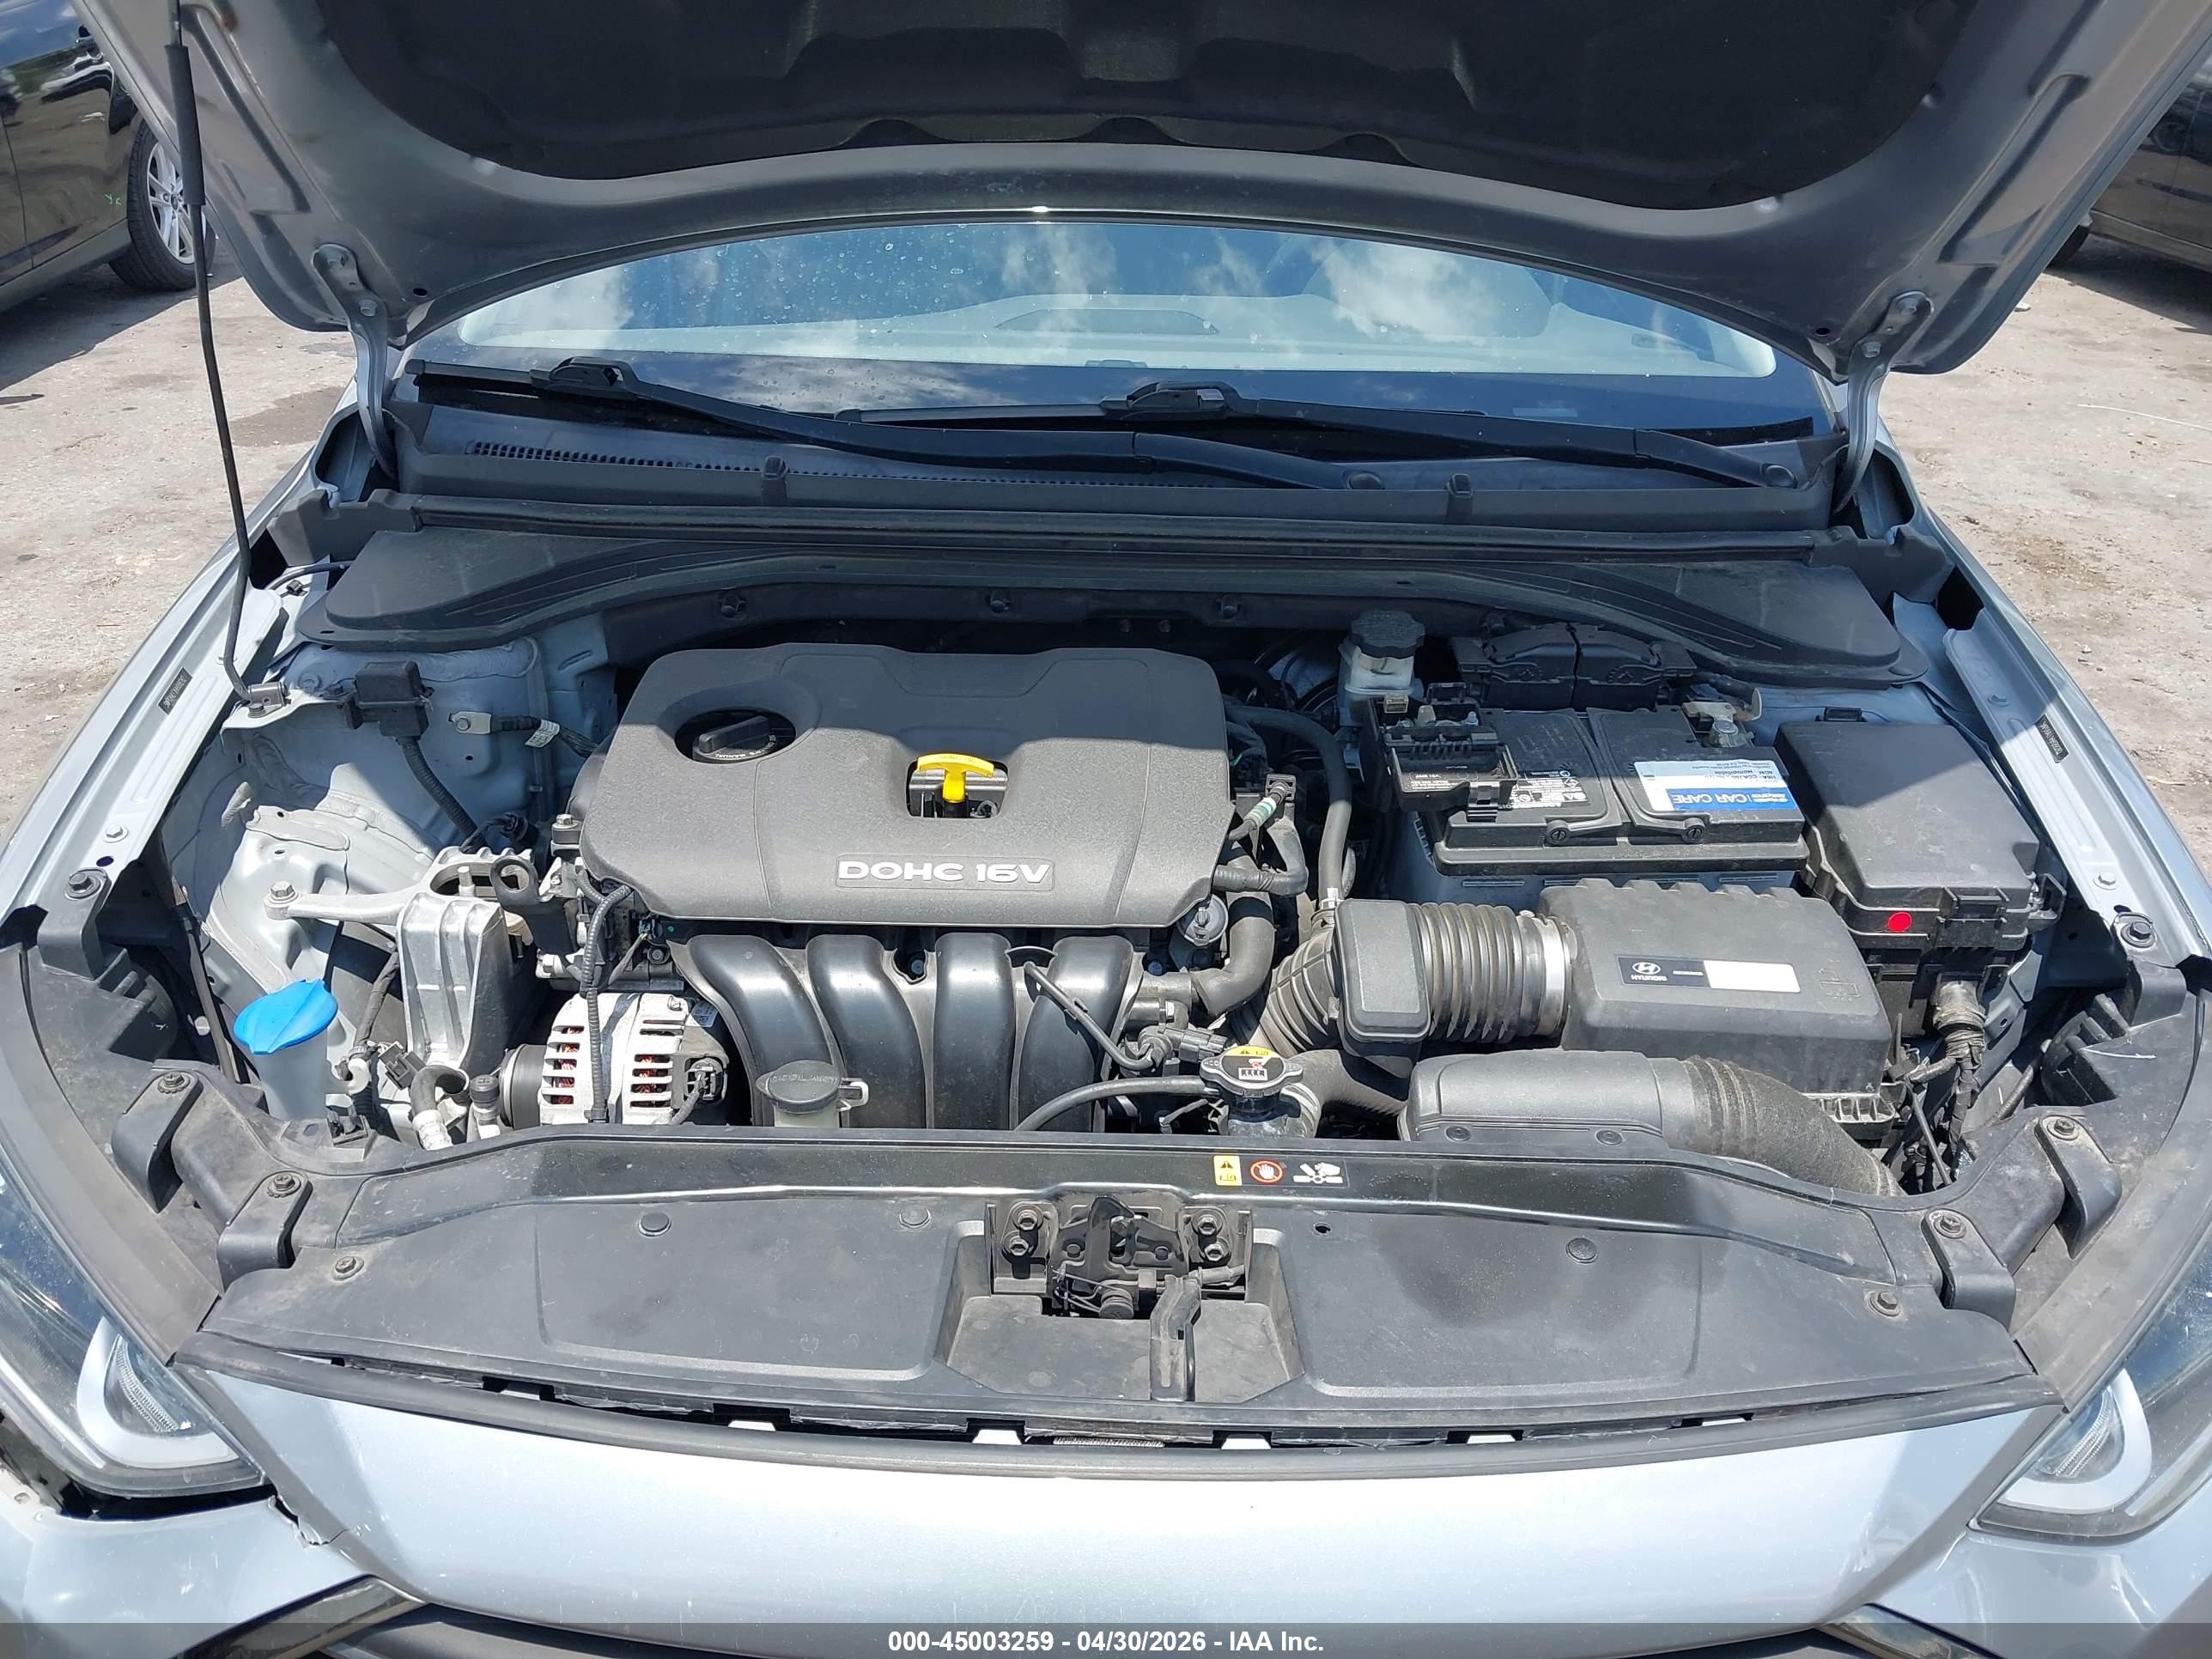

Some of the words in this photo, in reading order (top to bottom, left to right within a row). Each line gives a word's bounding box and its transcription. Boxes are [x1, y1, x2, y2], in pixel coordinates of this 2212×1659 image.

[1674, 793, 1713, 804] CARE
[1715, 793, 1748, 804] CAR
[839, 860, 964, 882] DOHC
[976, 863, 1051, 884] 16V
